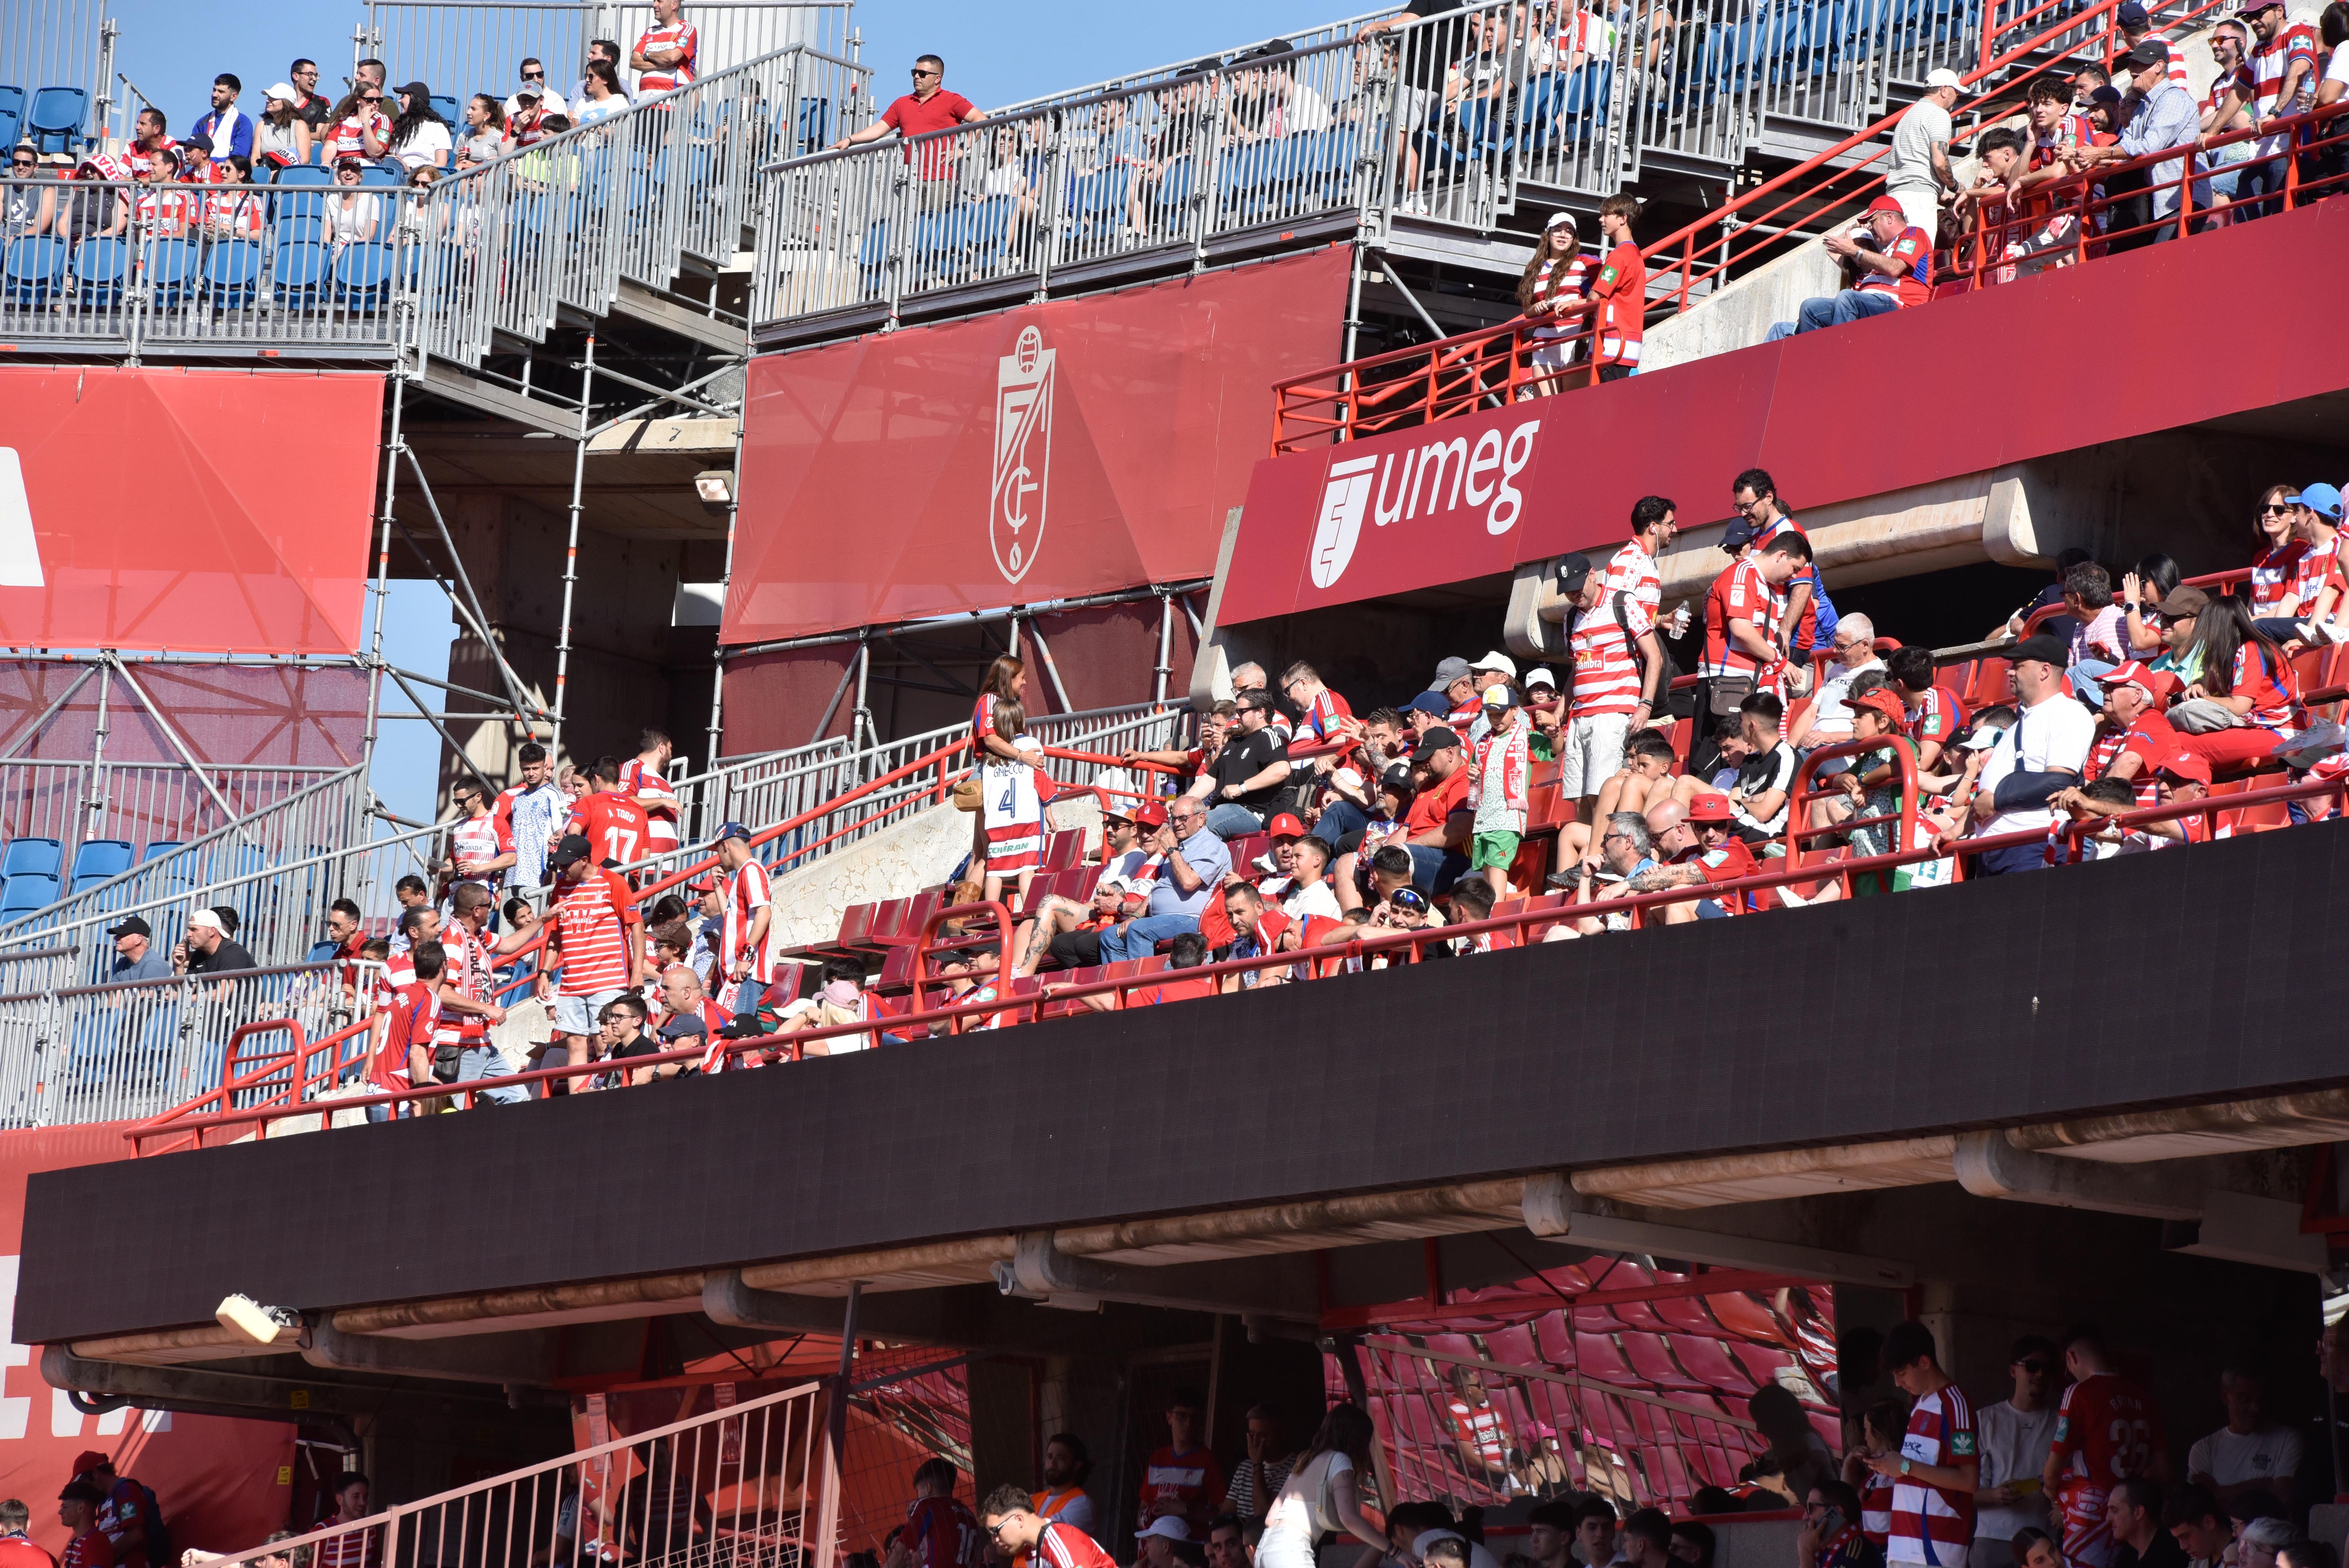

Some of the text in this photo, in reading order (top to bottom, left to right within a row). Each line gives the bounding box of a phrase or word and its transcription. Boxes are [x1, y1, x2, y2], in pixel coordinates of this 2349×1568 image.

[1374, 420, 1540, 535] umeg
[616, 808, 635, 823] TORO
[998, 777, 1016, 819] 4
[605, 826, 637, 864] 17
[376, 1010, 392, 1055] 9
[2109, 1419, 2150, 1479] 26
